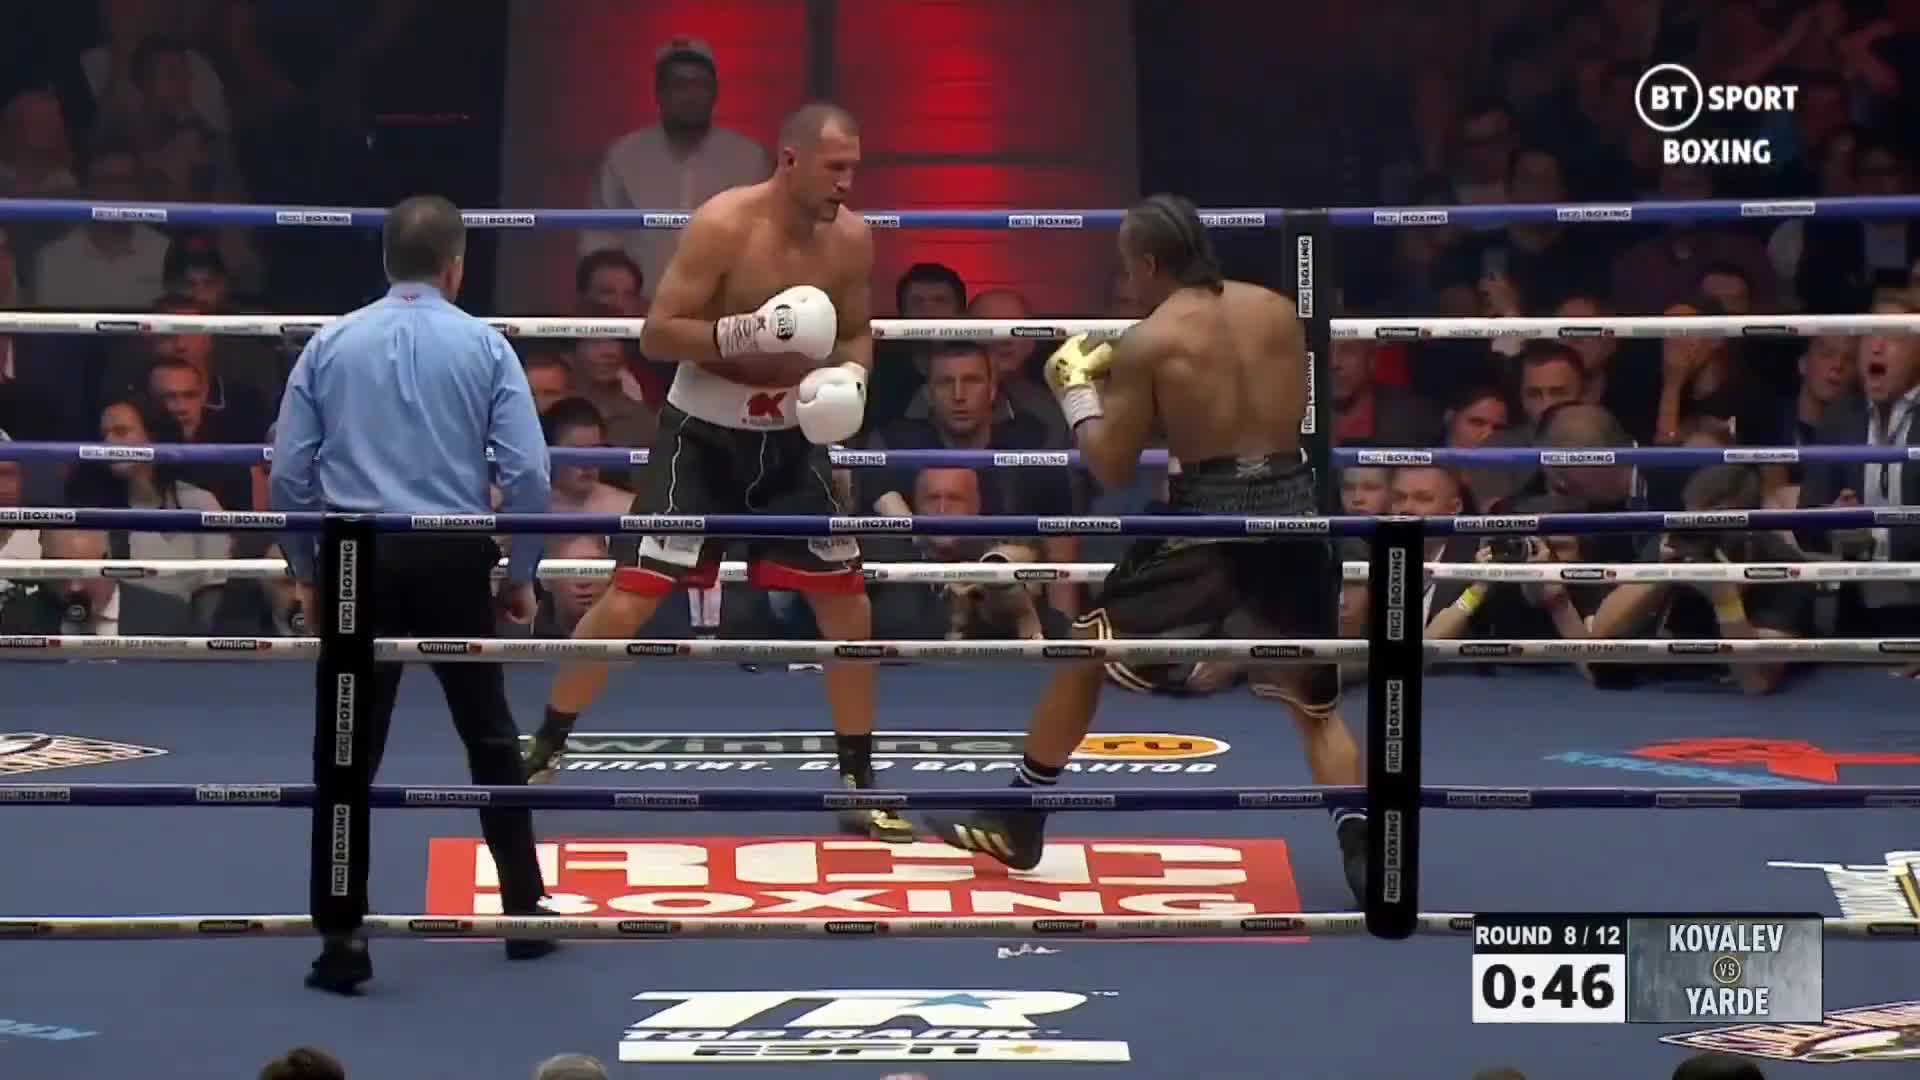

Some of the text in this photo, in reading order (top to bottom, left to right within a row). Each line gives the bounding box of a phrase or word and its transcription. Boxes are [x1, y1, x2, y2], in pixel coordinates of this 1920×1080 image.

[489, 216, 533, 225] BOXING
[1038, 217, 1081, 226] BOXING
[23, 511, 73, 521] BOXING
[234, 515, 284, 525] BOXING
[1694, 515, 1747, 525] BOXING
[445, 517, 495, 527] BOXING
[654, 517, 703, 528] BOXING
[862, 518, 911, 528] BOXING
[1069, 520, 1119, 530] BOXING
[1278, 520, 1328, 530] BOXING
[1486, 519, 1536, 529] BOXING
[342, 542, 354, 598] BOXING
[1391, 550, 1403, 605] BOXING
[340, 675, 352, 731] BOXING
[1389, 683, 1400, 736] BOXING
[911, 760, 1217, 773] ВАРАНТОВ
[335, 806, 347, 861] BOXING
[1387, 814, 1398, 866] BOXING
[473, 890, 1256, 915] BOXING
[623, 1029, 1040, 1040] TOP RANK
